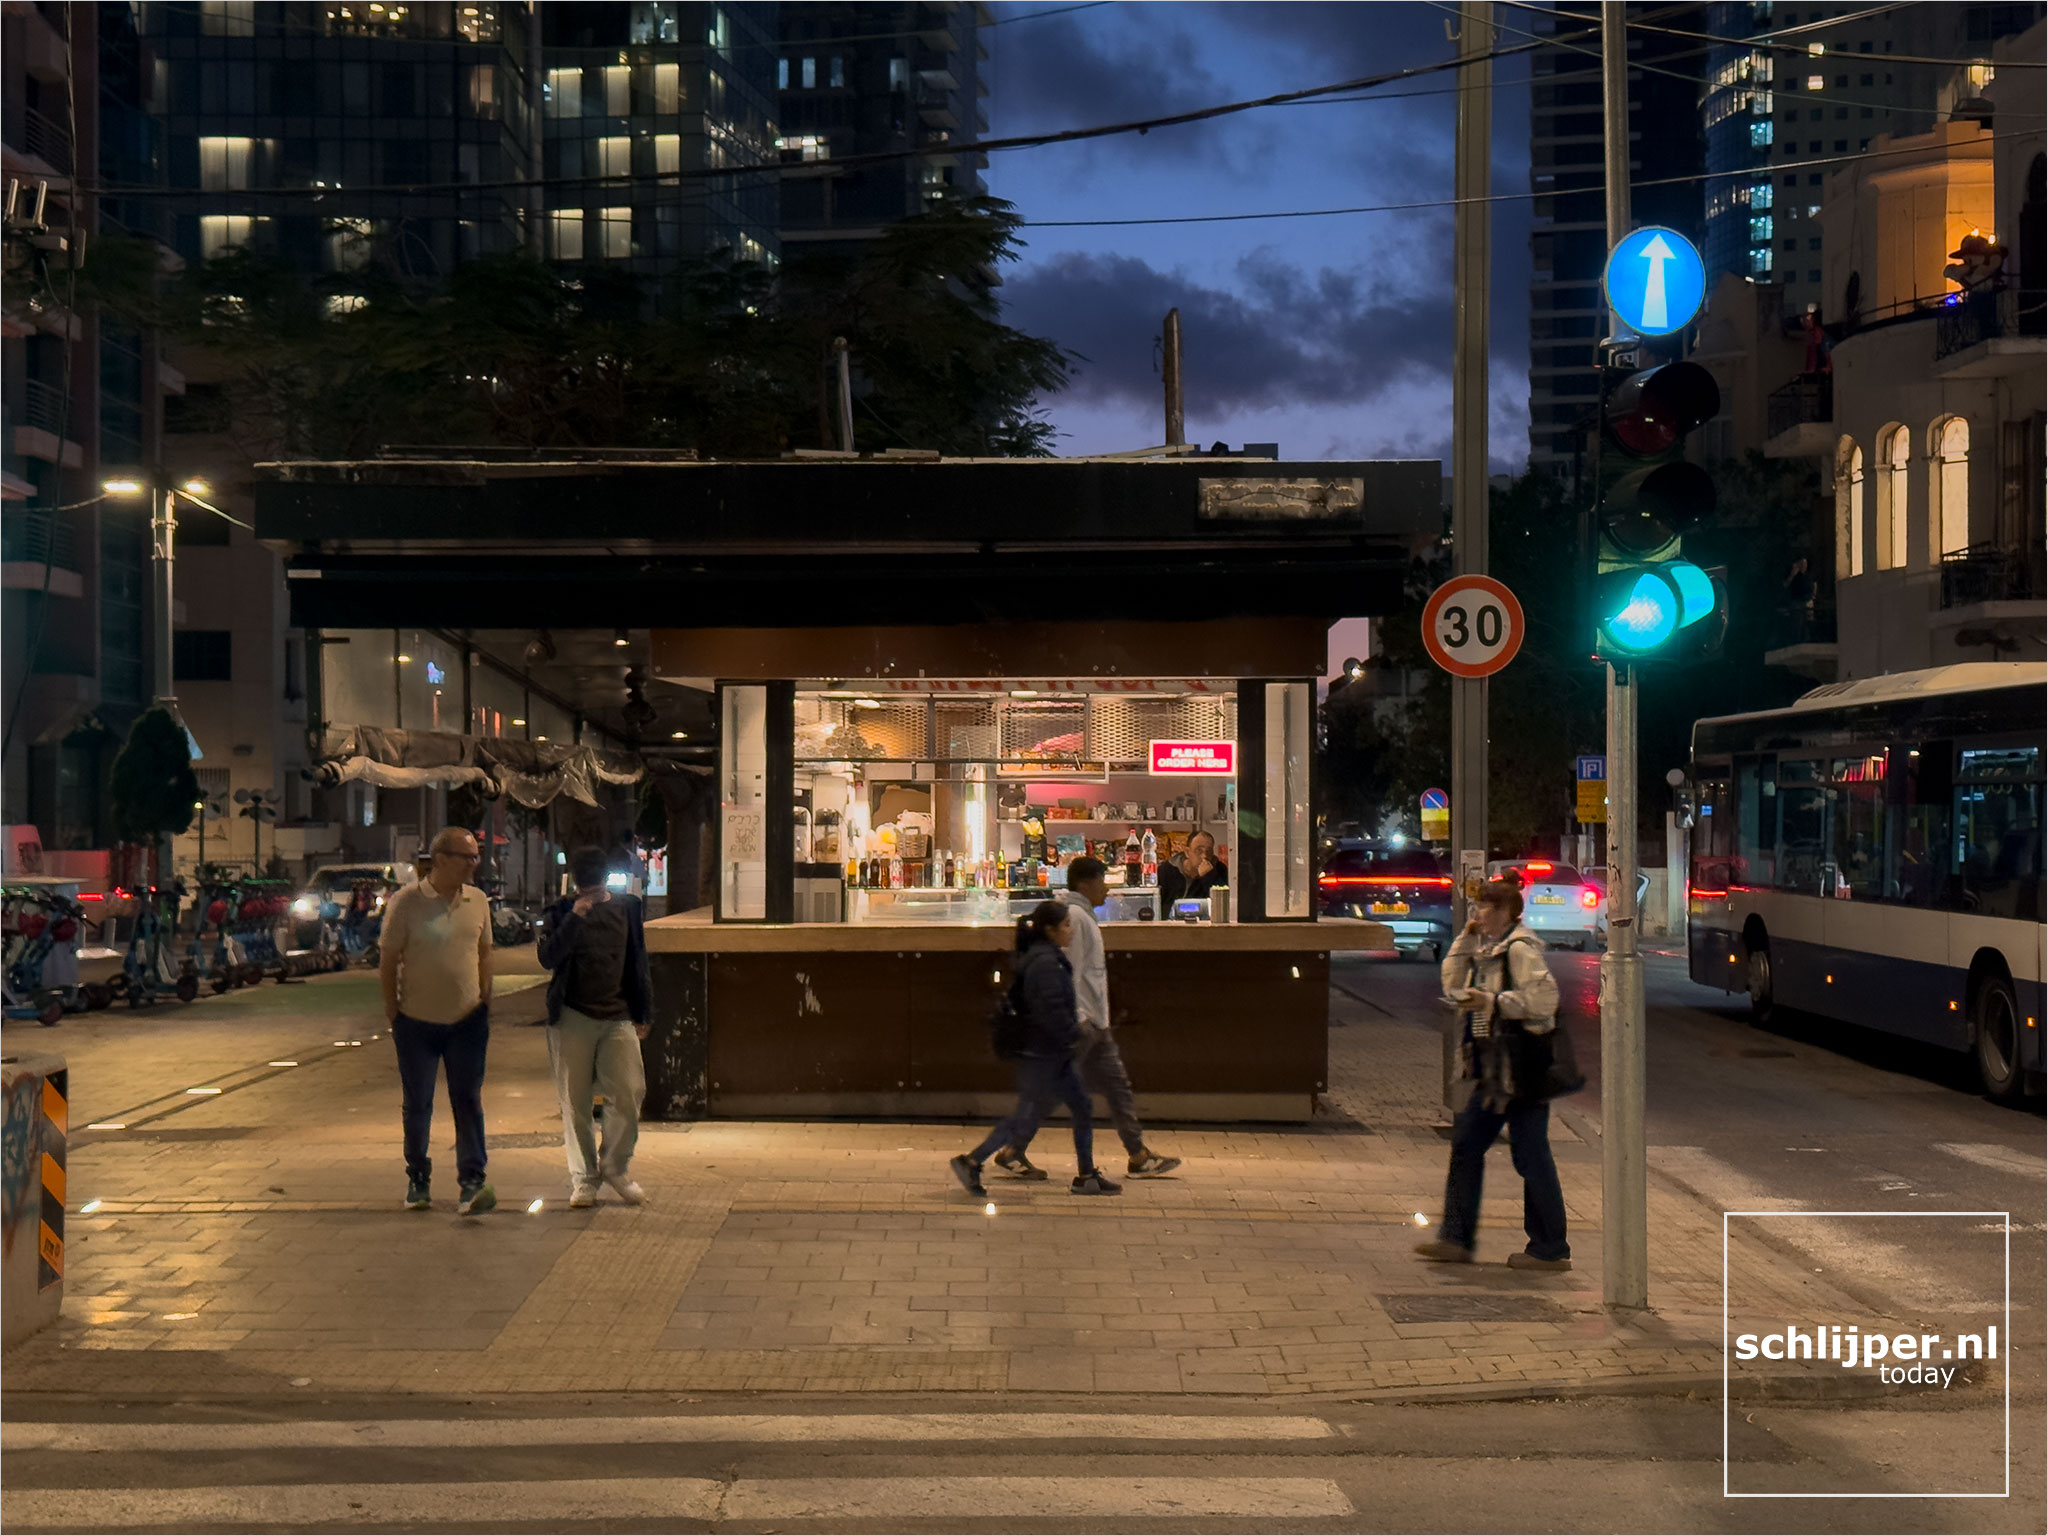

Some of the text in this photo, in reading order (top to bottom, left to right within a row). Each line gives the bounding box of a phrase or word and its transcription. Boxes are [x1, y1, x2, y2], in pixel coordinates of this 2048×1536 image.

[1443, 604, 1502, 648] 30
[1171, 748, 1214, 758] PLEASE
[1157, 758, 1227, 768] ORDER HERE
